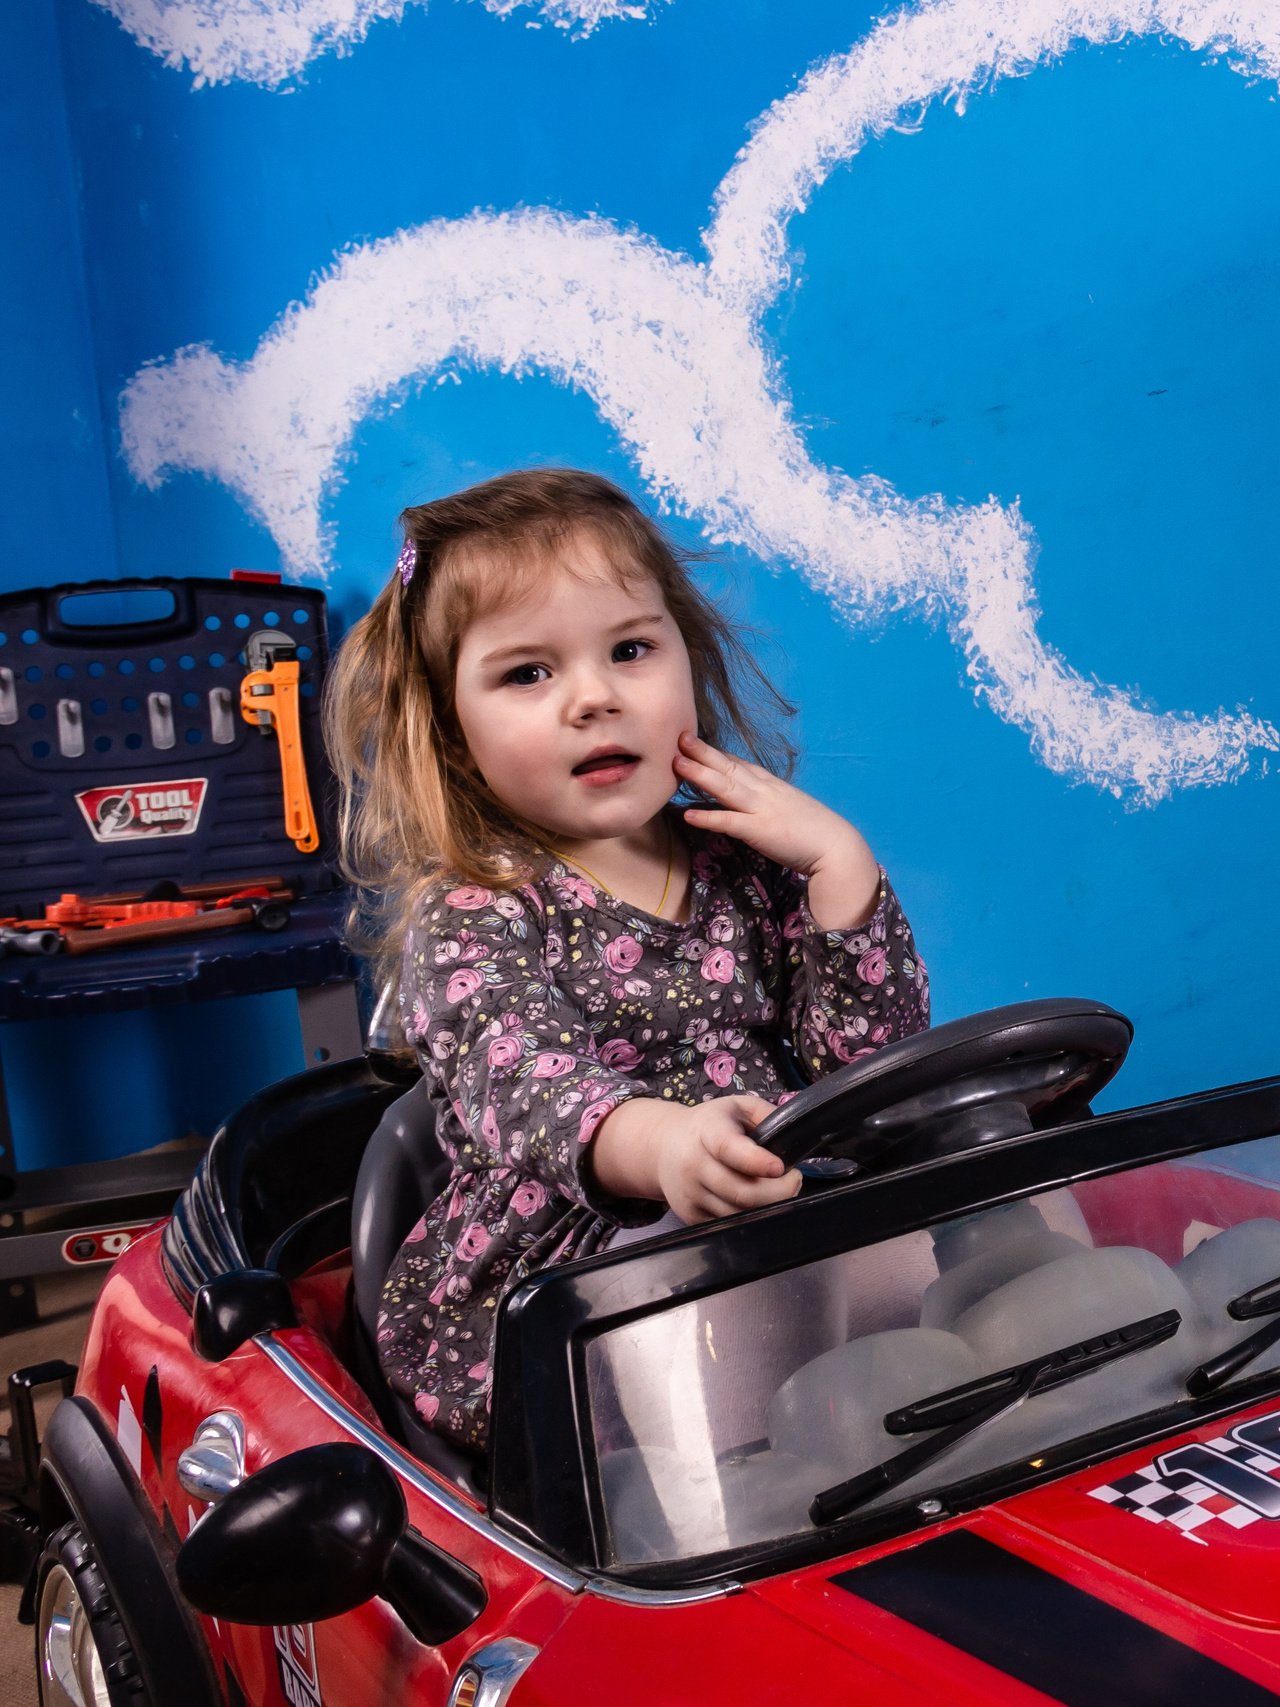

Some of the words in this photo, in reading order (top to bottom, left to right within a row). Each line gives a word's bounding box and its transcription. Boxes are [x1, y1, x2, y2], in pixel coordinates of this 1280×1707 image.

[135, 789, 193, 809] TOOL
[141, 808, 192, 824] Quality
[281, 1658, 319, 1707] BAB
